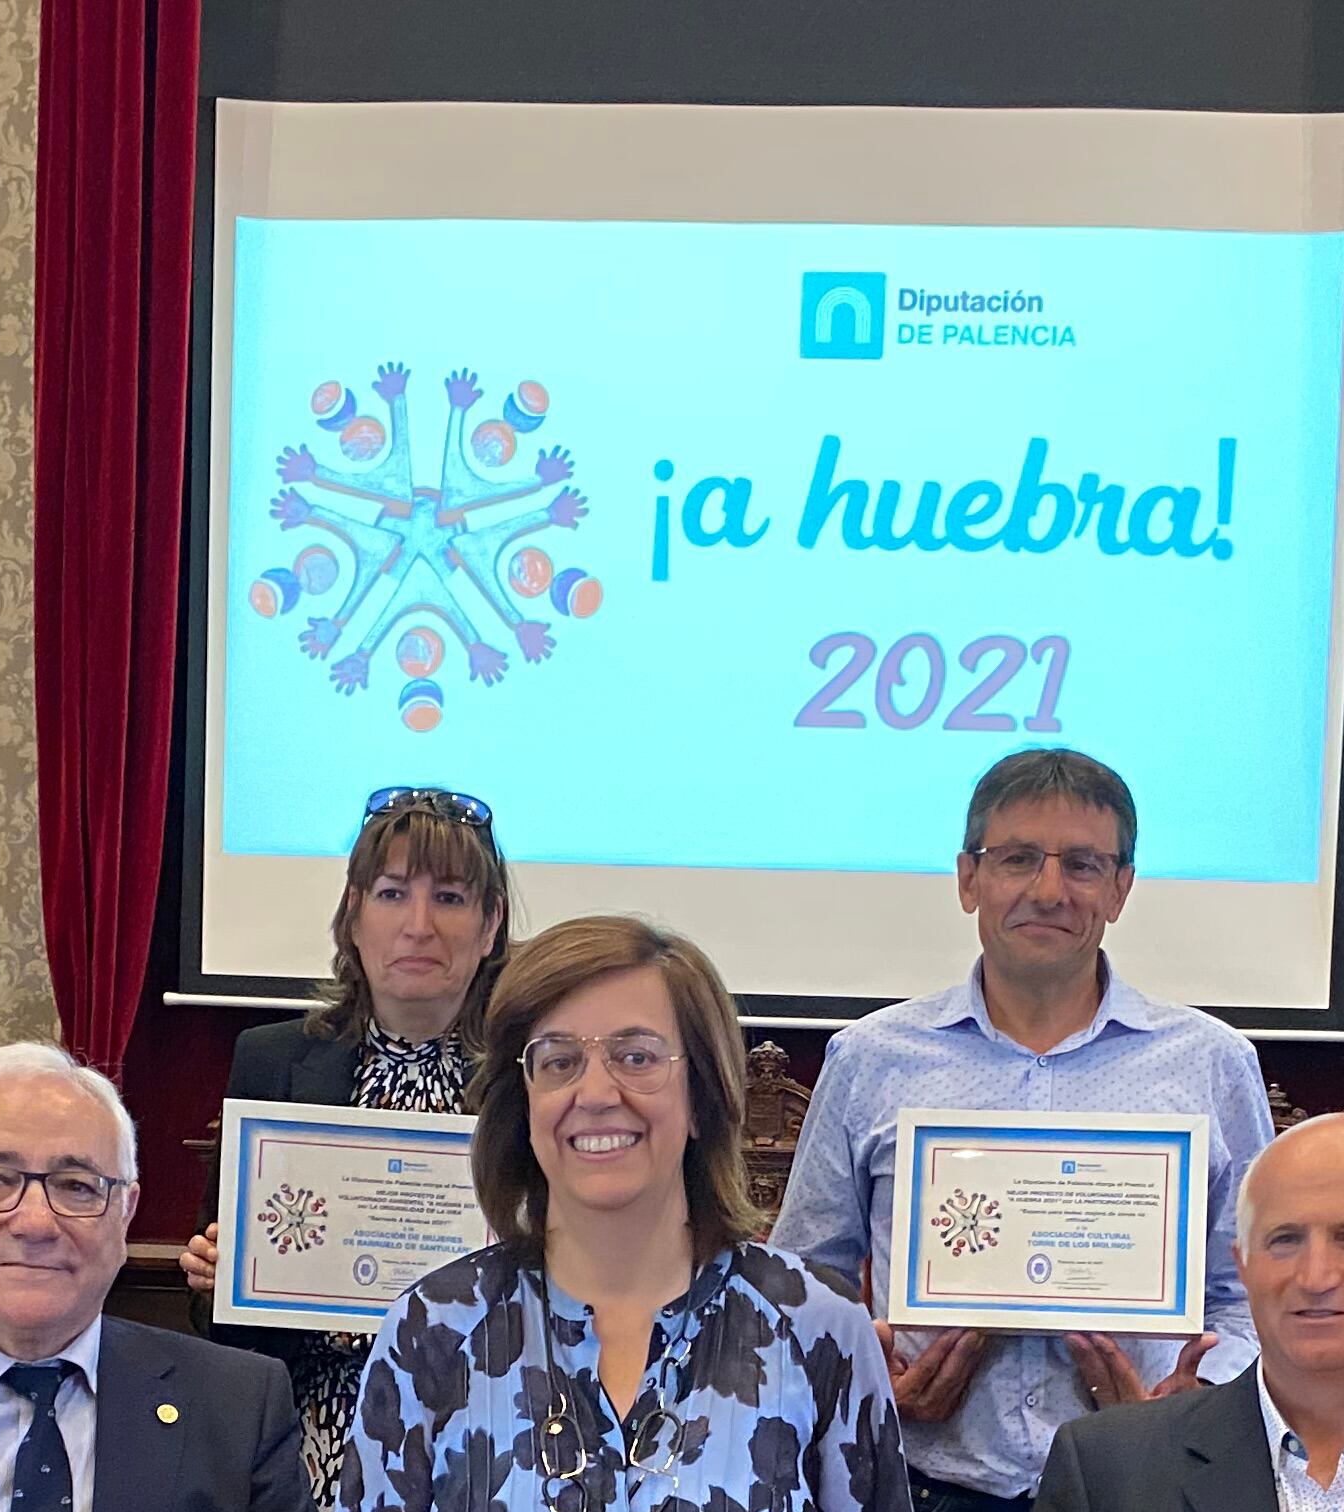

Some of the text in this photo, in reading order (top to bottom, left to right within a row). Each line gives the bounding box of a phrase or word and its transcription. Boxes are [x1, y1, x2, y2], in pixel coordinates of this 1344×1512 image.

[898, 289, 1043, 316] Diputación
[898, 324, 1076, 346] DE PALENCIA
[652, 435, 1237, 581] ¡a huebra!
[793, 631, 1072, 732] 2021
